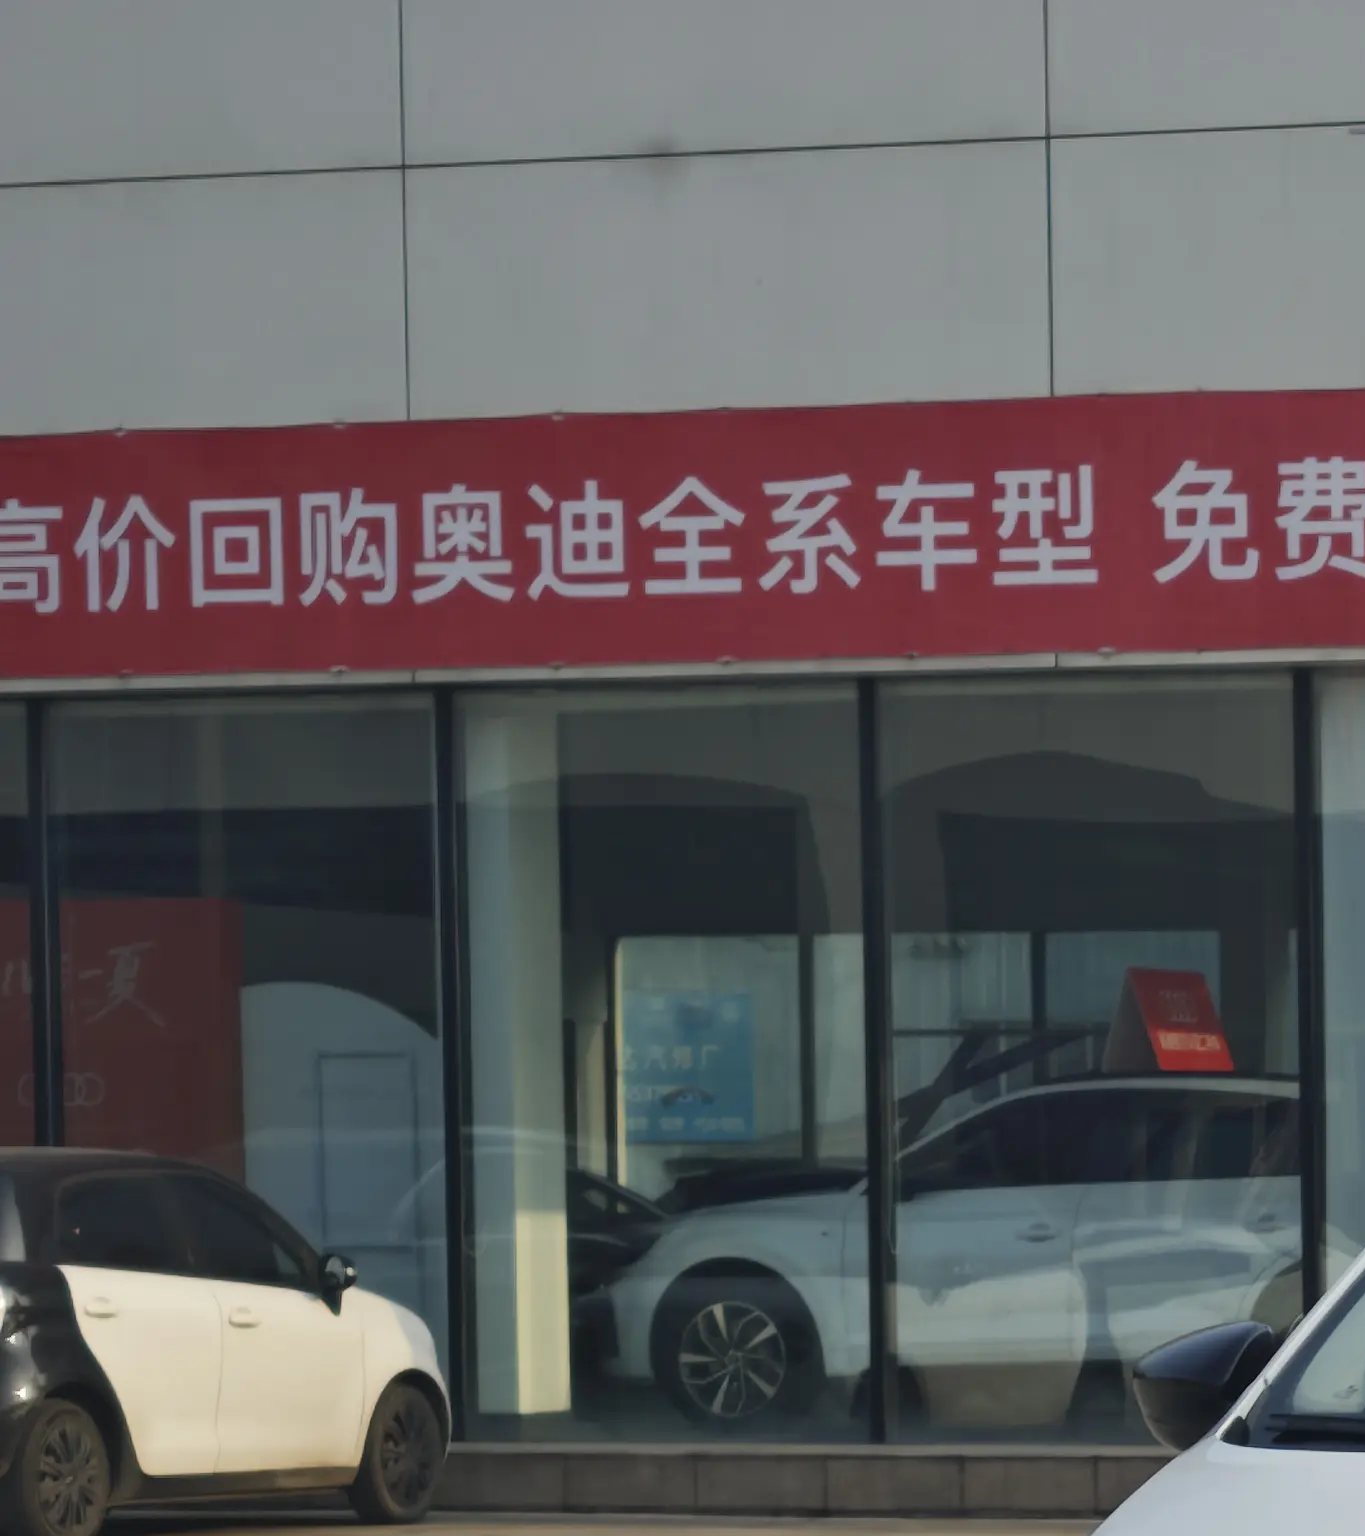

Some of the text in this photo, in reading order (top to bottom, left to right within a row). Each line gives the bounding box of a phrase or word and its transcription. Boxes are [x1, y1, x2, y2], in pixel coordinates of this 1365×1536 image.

[0, 464, 1098, 614] 高价回购奥迪全系车型
